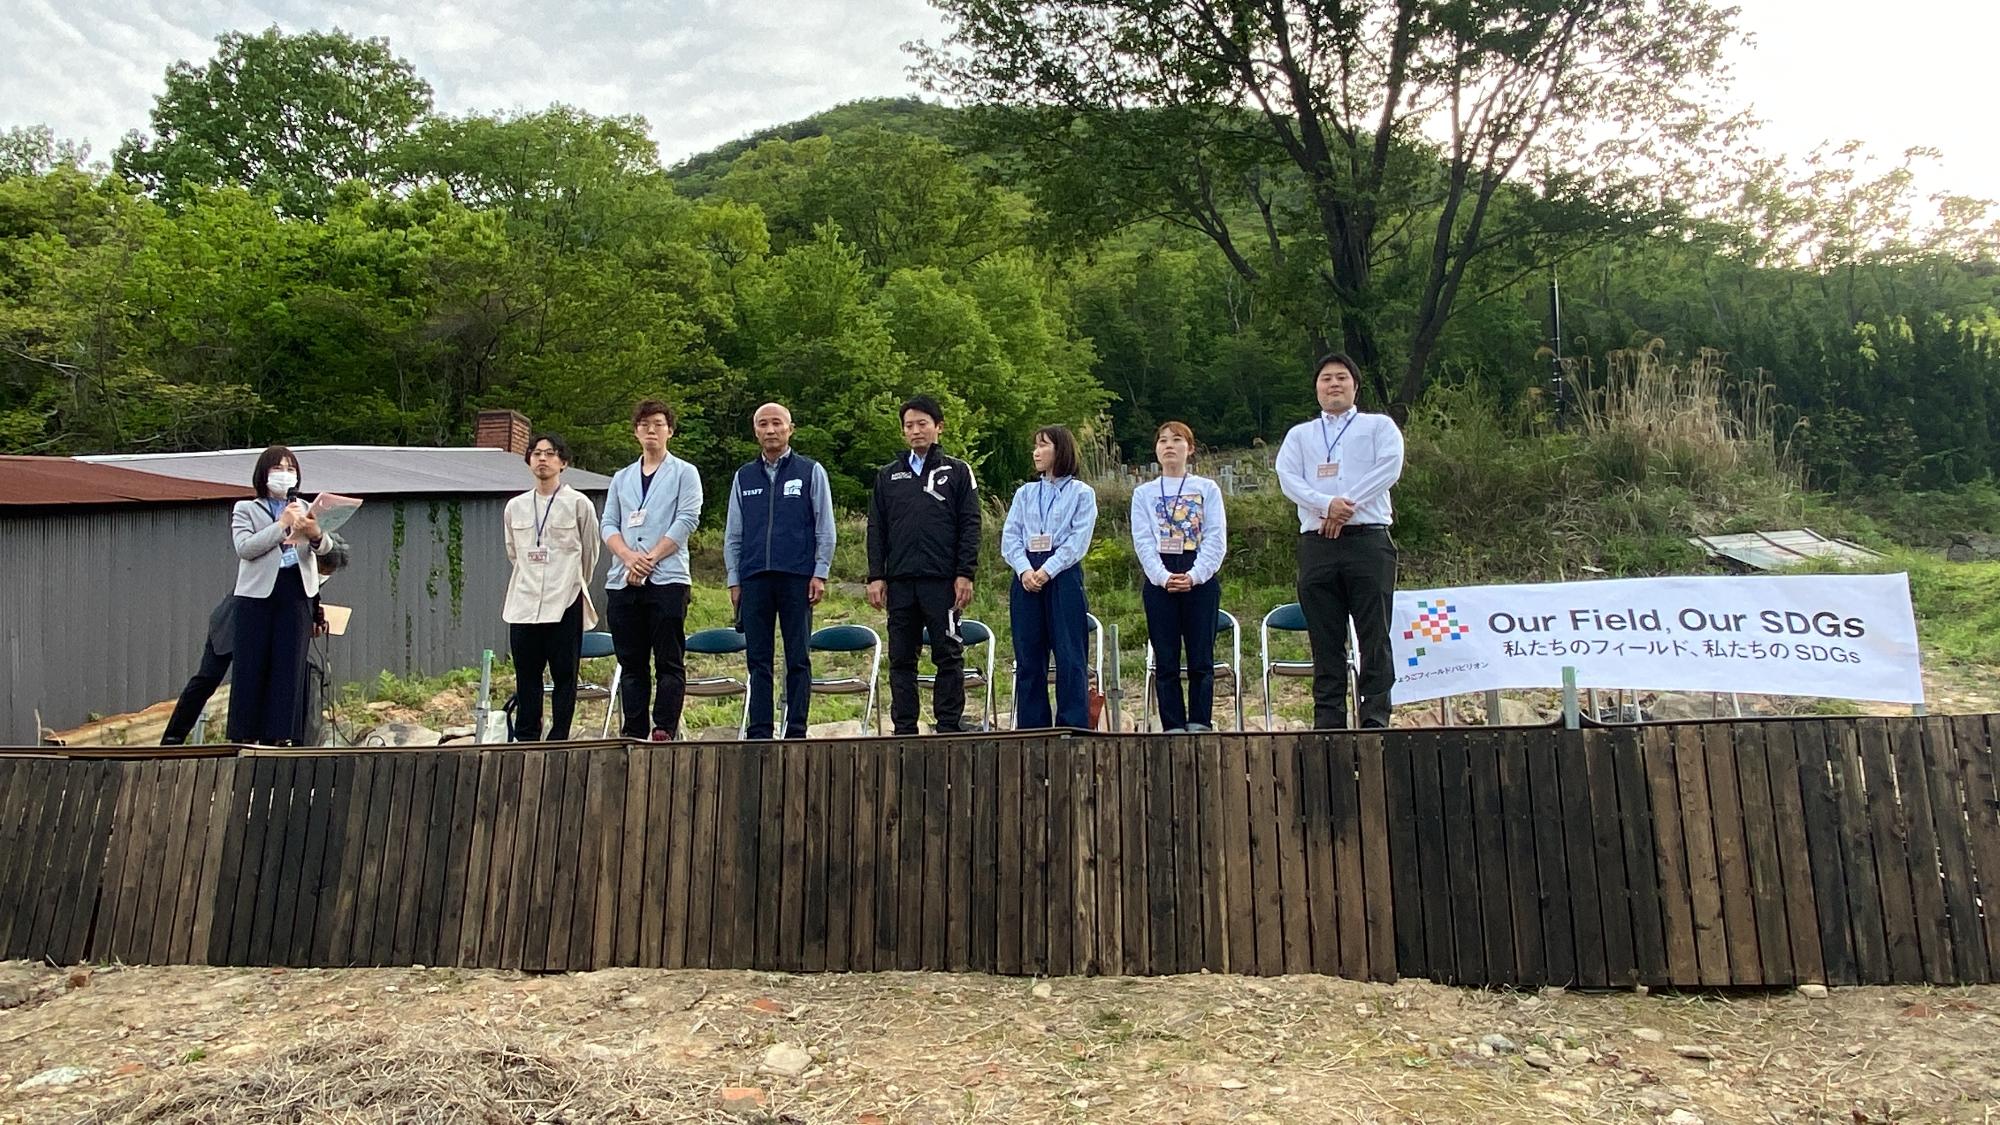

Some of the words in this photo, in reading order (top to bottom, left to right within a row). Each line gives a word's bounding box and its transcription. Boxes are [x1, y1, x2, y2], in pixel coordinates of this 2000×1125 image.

[1488, 612, 1557, 634] Our
[1569, 608, 1671, 635] Field,
[1678, 608, 1747, 632] Our
[1760, 610, 1865, 638] SDGs
[1395, 662, 1489, 683] ょうごフィールドパビリオン
